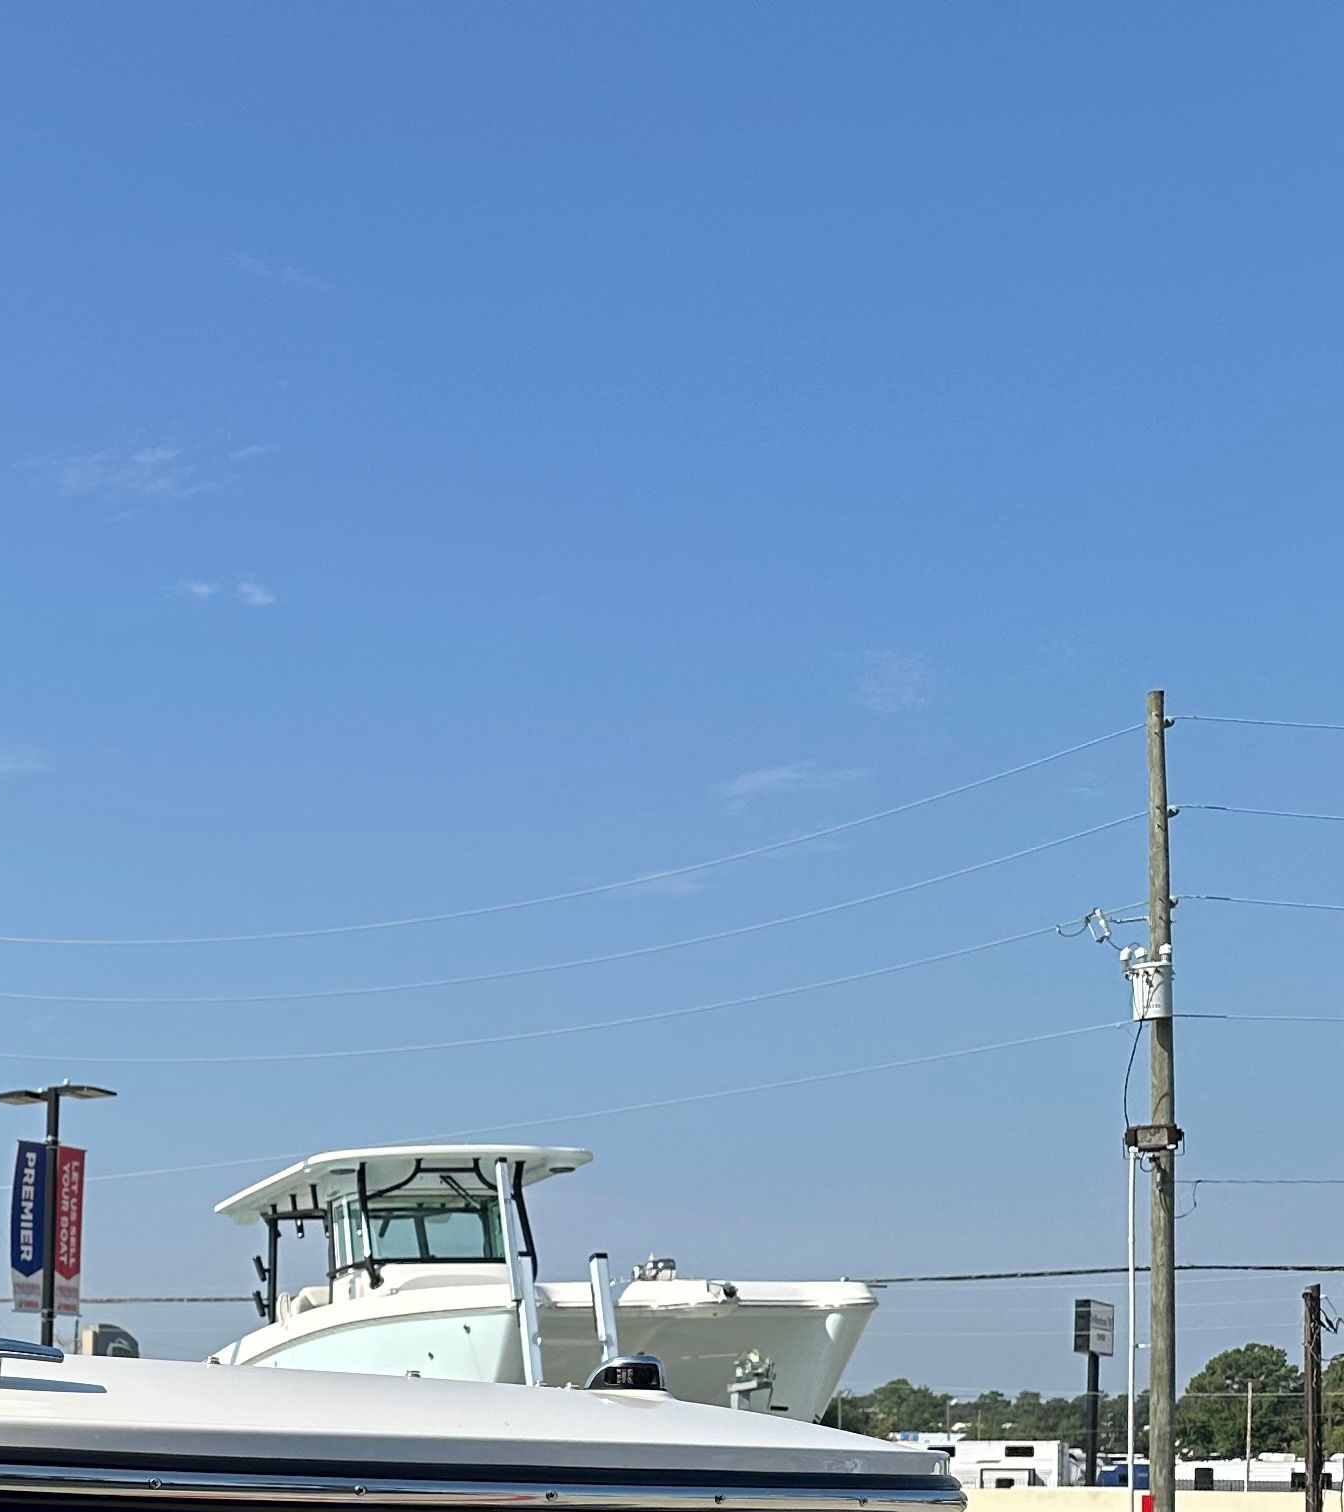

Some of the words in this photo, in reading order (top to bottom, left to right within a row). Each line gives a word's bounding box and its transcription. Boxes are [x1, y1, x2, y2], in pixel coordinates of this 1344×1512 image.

[61, 1162, 71, 1211] YOUR
[71, 1161, 80, 1195] LET
[20, 1152, 37, 1261] PREMIER
[70, 1198, 78, 1221] US
[59, 1216, 69, 1265] BOAT
